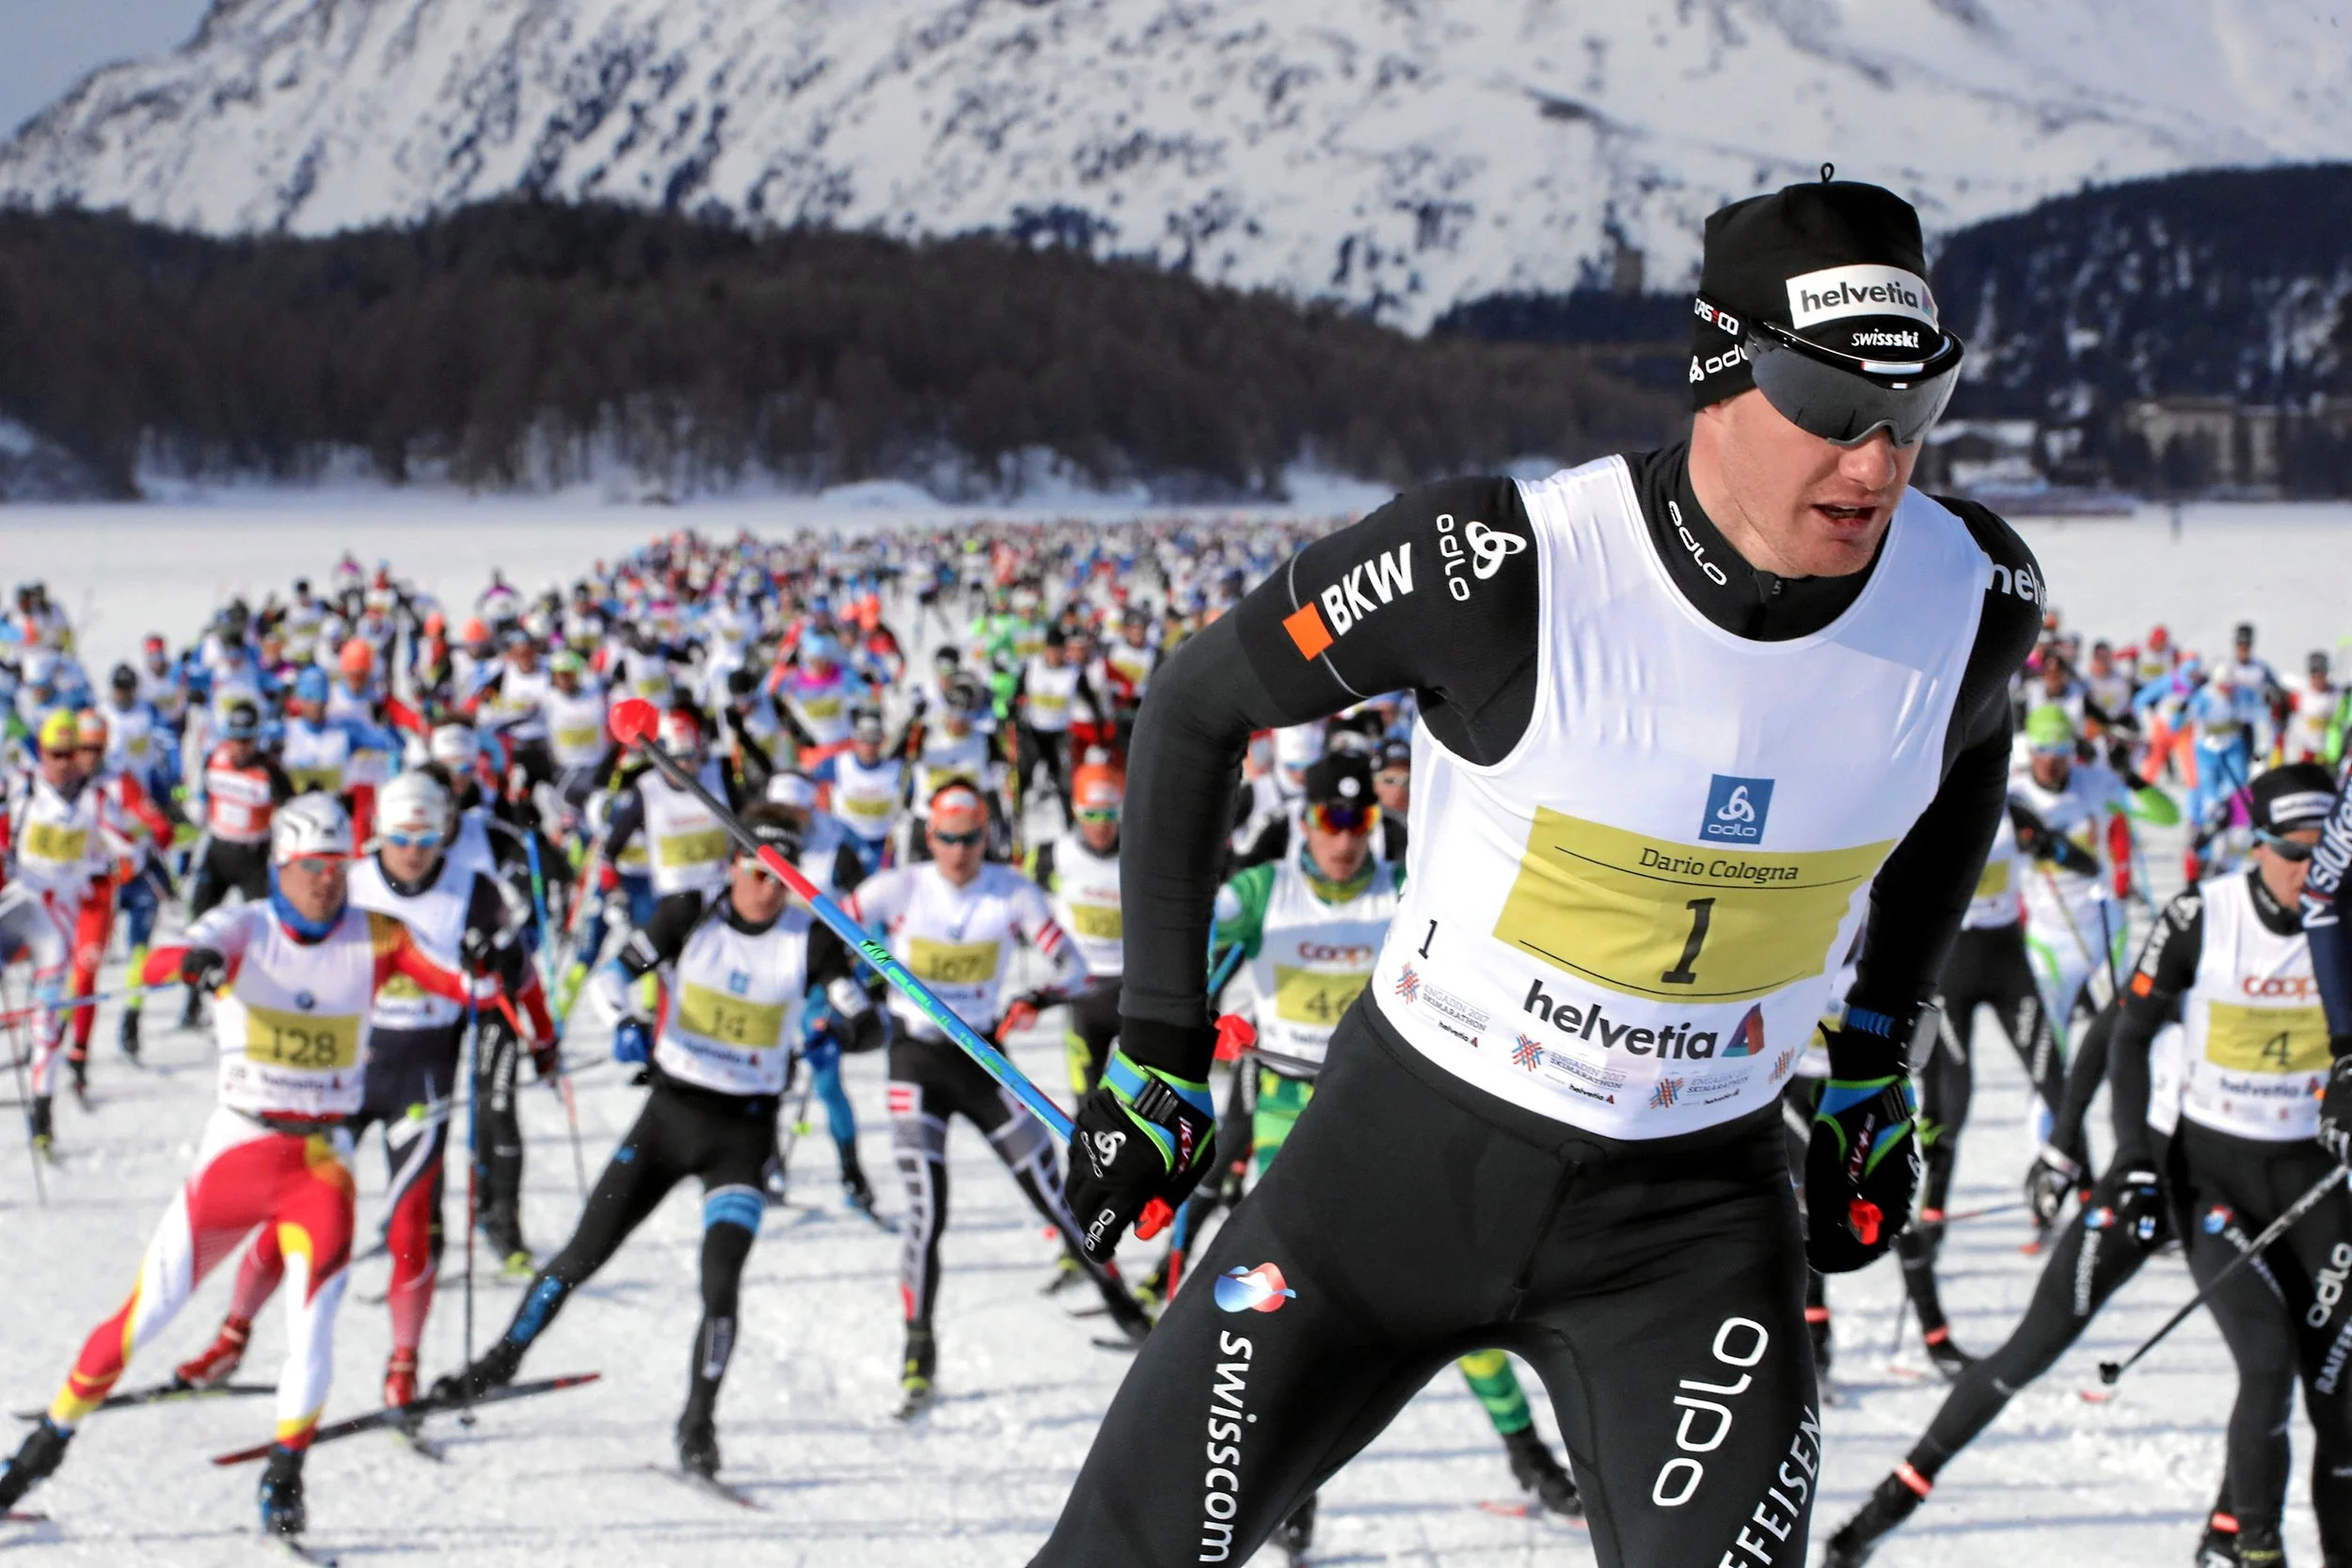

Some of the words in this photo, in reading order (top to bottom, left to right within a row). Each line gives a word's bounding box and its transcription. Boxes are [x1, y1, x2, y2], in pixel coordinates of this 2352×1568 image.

[1801, 281, 1918, 313] helvetia
[1705, 343, 1749, 374] odl
[1851, 327, 1919, 349] swissski
[1436, 514, 1470, 602] odlo
[1668, 500, 1727, 586] odlo
[1320, 542, 1415, 636] BKW
[1707, 823, 1757, 837] odlo
[1639, 847, 1704, 876] Dario
[1708, 861, 1799, 884] Cologna
[1418, 919, 1438, 959] 1
[1661, 897, 1717, 985] 1
[1523, 978, 1720, 1060] helvetia
[272, 1026, 337, 1068] 128
[2261, 1030, 2291, 1067] 4
[1568, 1083, 1604, 1101] helvetia
[1652, 1317, 1770, 1506] odlo
[1199, 1330, 1258, 1562] swisscom
